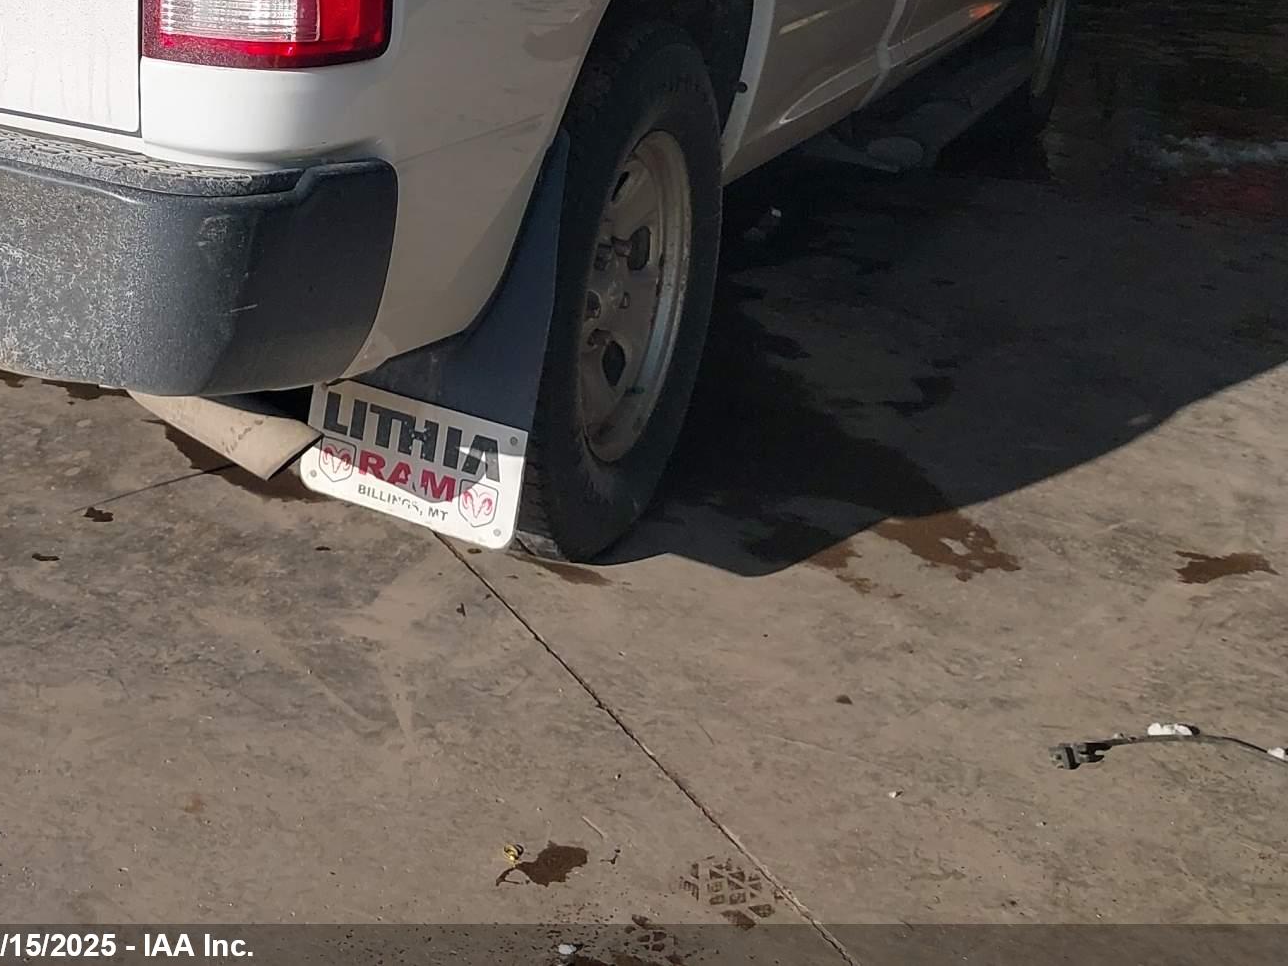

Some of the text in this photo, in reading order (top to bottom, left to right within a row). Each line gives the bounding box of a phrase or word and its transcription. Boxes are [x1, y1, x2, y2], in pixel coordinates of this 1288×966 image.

[323, 391, 501, 483] LITHIA
[358, 449, 457, 503] RAM
[427, 506, 449, 522] MT
